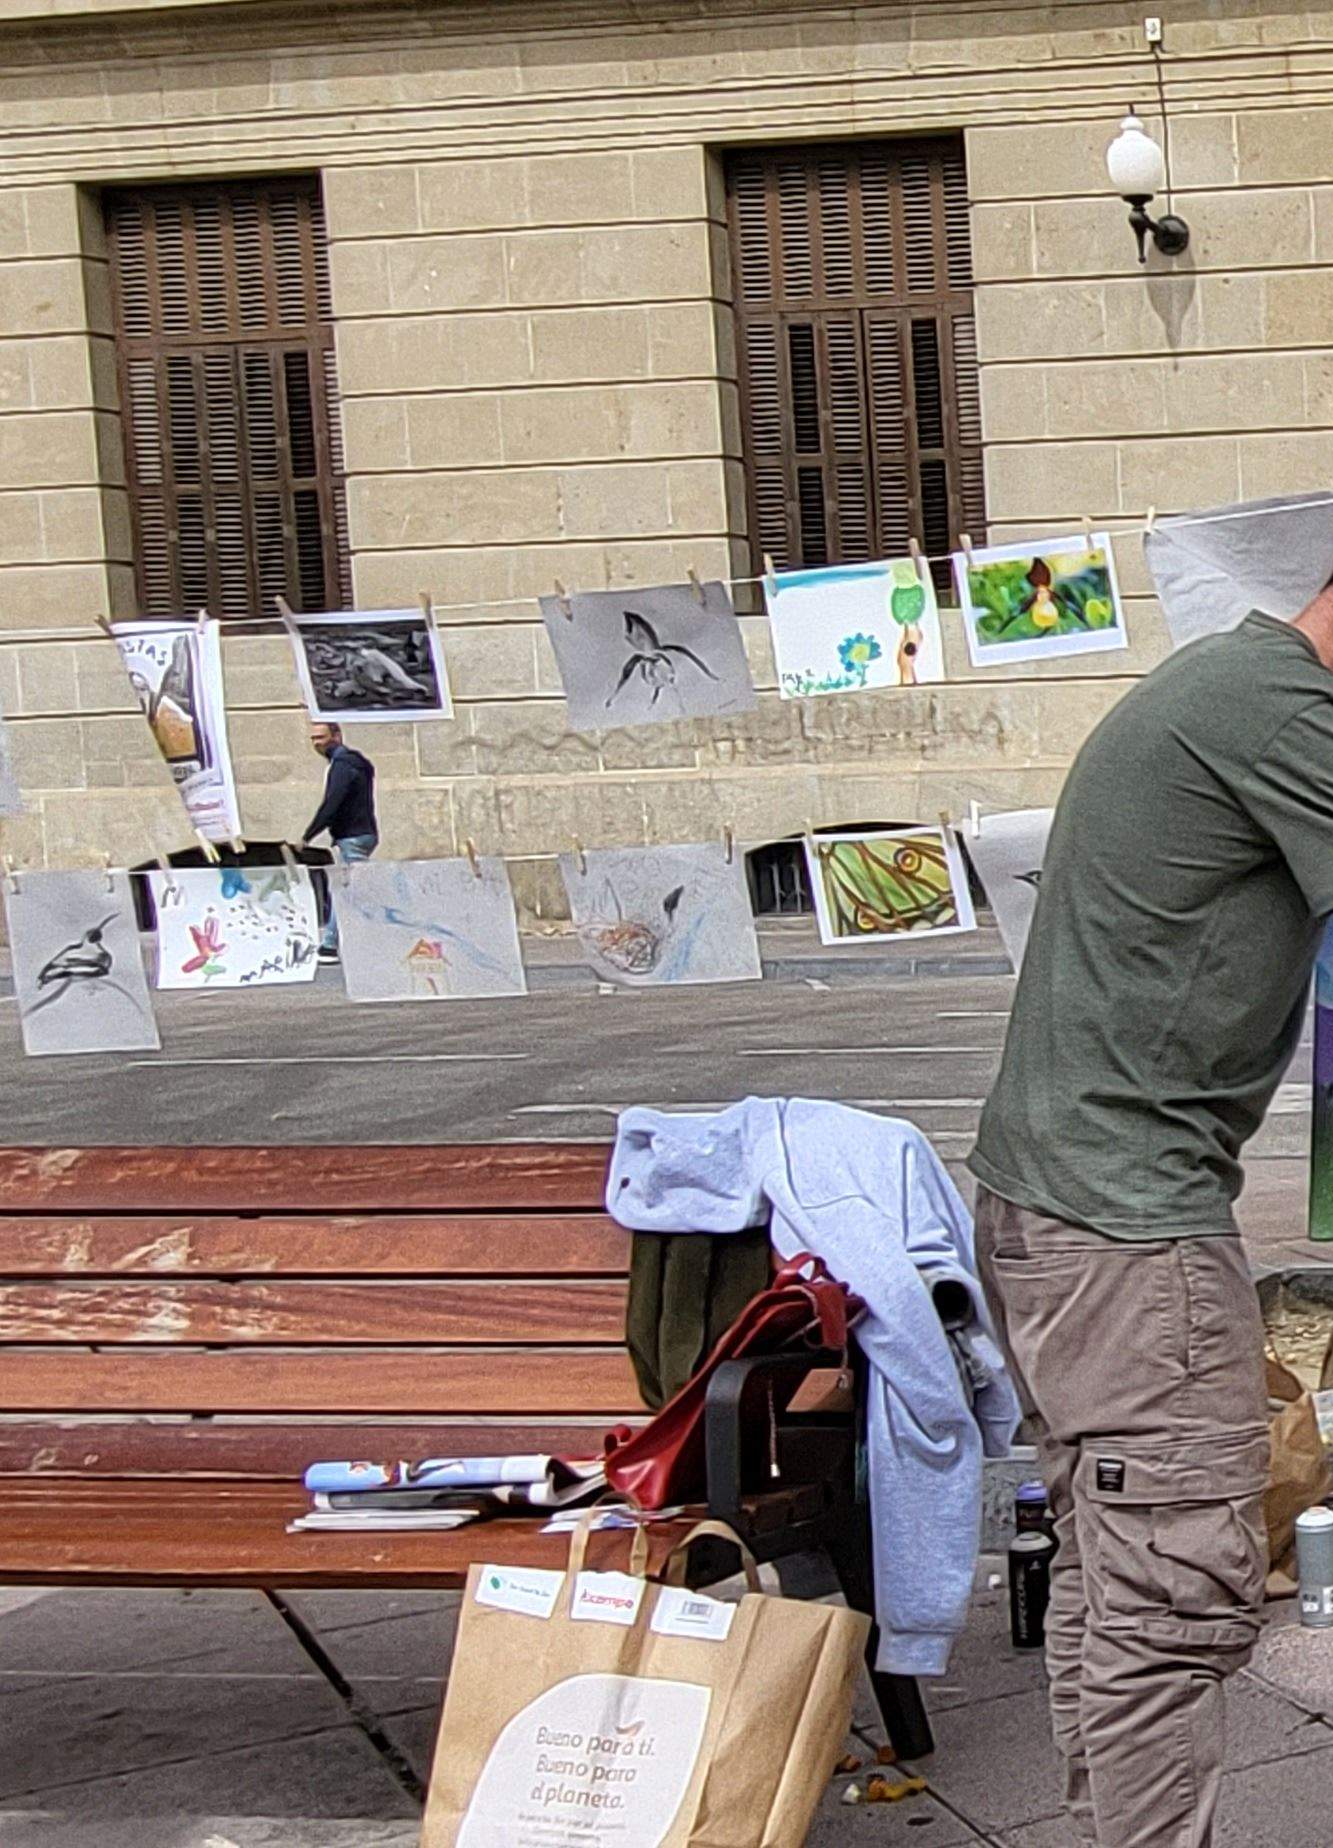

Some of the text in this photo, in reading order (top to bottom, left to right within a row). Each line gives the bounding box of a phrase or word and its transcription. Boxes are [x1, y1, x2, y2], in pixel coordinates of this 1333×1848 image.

[536, 1726, 656, 1756] Bueno para ti.
[536, 1754, 637, 1785] Bueno para
[544, 1782, 625, 1808] planeta.
